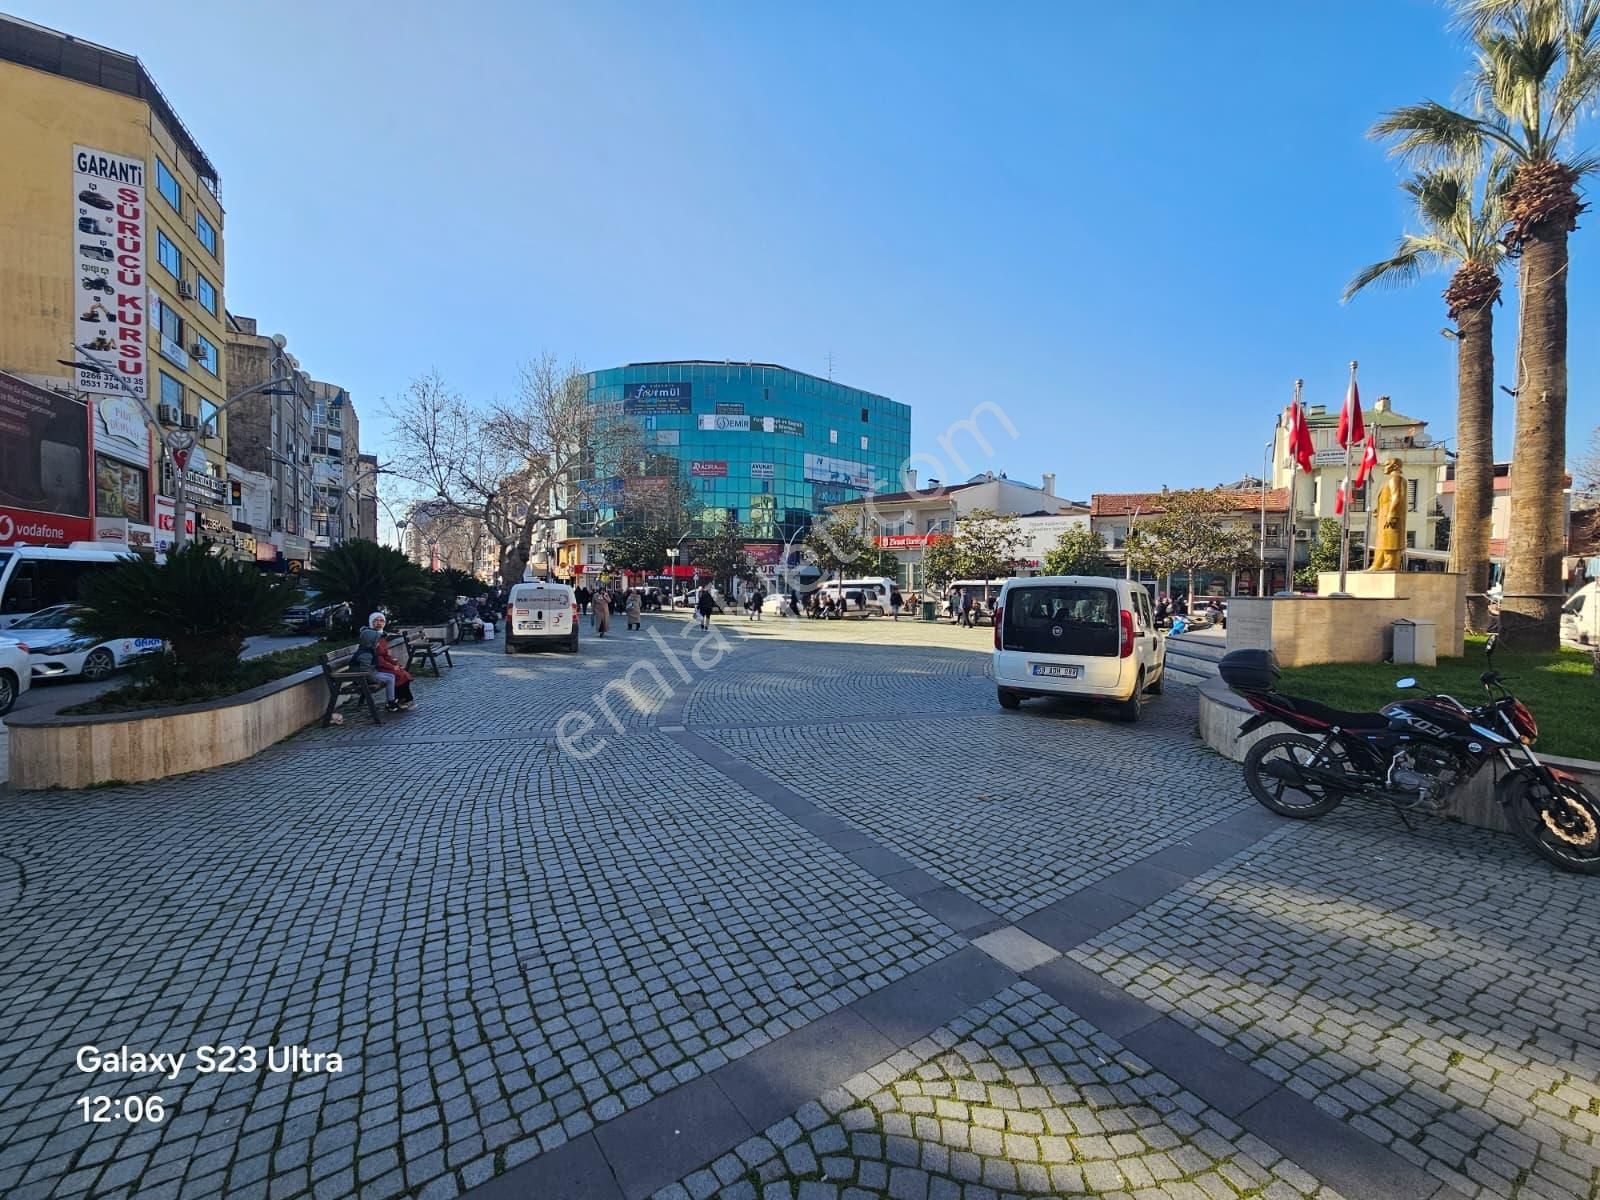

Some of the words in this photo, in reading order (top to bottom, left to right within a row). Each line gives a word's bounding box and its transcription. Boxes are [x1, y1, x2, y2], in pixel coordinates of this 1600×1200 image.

[117, 293, 143, 376] KURSU
[80, 379, 101, 388] 0531
[16, 524, 65, 539] vodafone
